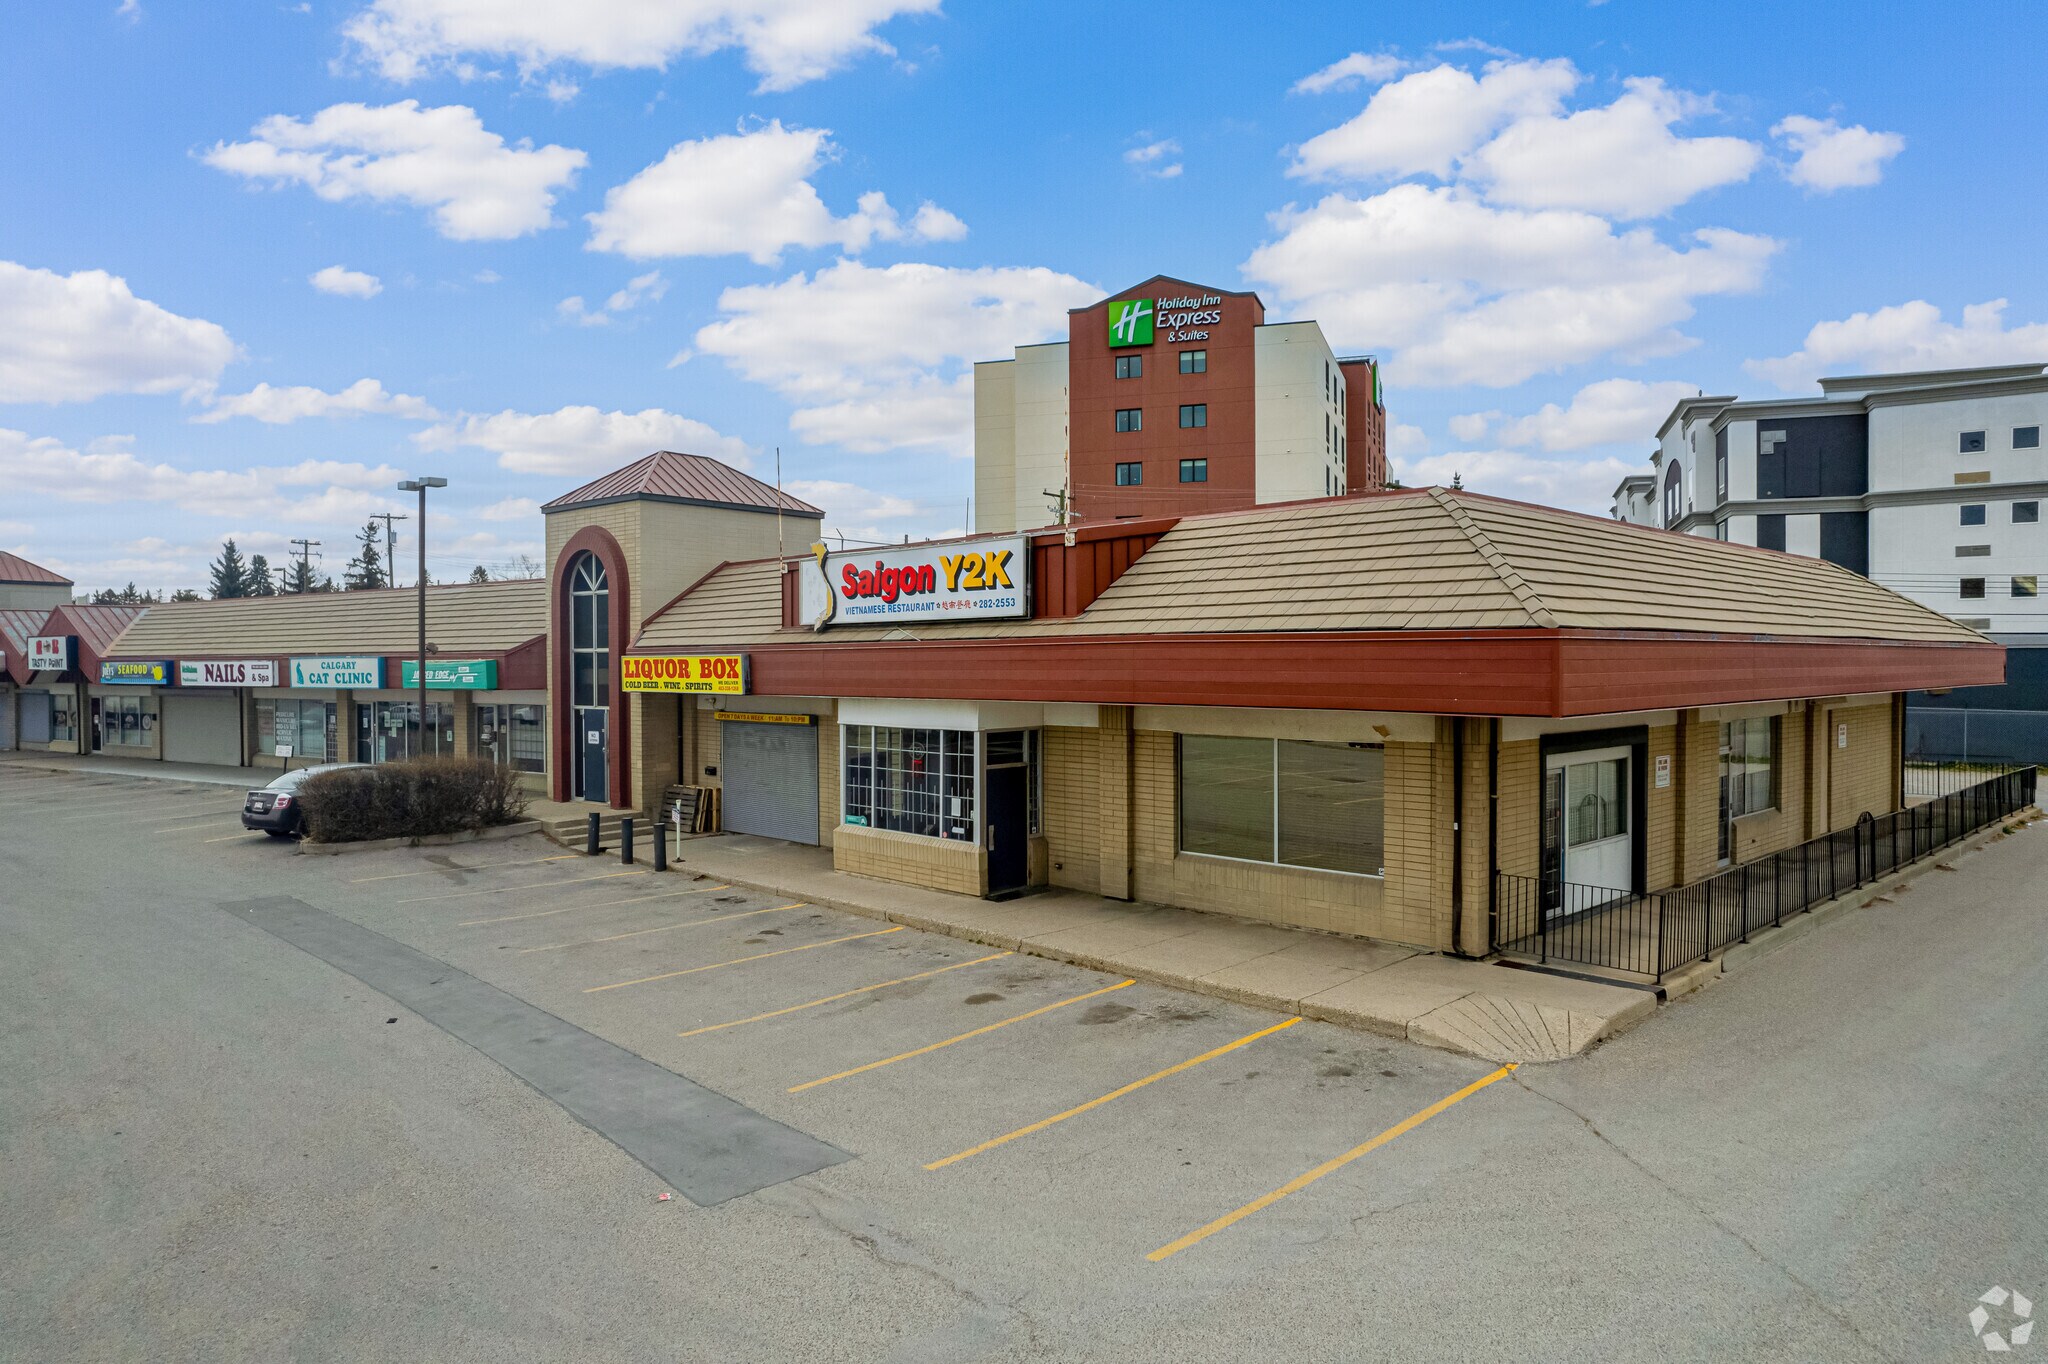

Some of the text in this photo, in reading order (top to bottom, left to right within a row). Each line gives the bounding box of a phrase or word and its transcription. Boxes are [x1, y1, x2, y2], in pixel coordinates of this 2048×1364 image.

[1157, 294, 1221, 310] Holiday Inn
[1157, 310, 1221, 331] Express
[1168, 330, 1209, 343] & Suites
[841, 550, 1015, 604] Saigon Y2K
[845, 602, 935, 615] VIETNAMESE RESTAURANT
[32, 658, 63, 668] TASTY POINT
[321, 661, 357, 670] CALGARY
[624, 658, 739, 680] LIQUOR BOX
[117, 664, 147, 675] SEAFOOD
[204, 663, 246, 683] NAILS
[434, 670, 450, 679] EDGE
[252, 673, 269, 683] & Spa
[309, 672, 373, 684] CAT CLINIC
[625, 681, 713, 691] COLD BEER WINE SPIRITS
